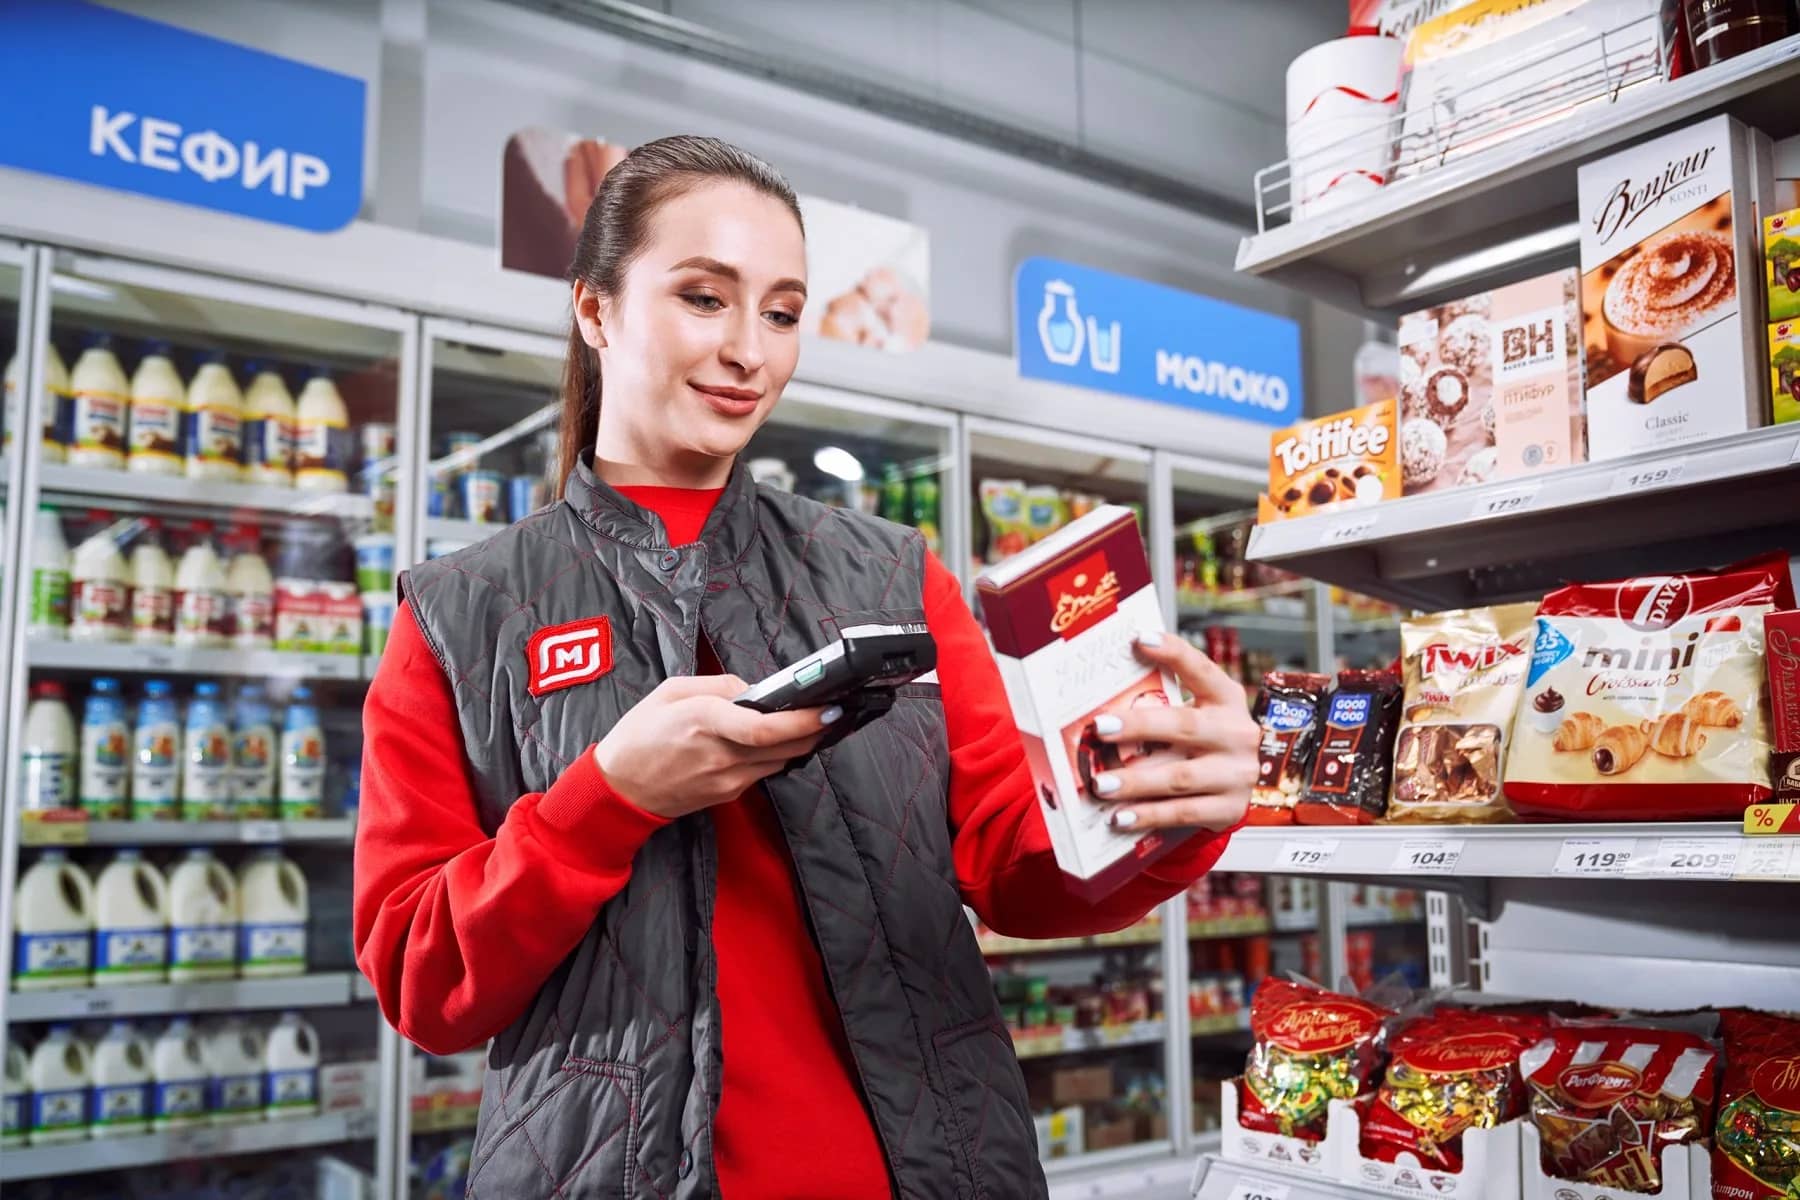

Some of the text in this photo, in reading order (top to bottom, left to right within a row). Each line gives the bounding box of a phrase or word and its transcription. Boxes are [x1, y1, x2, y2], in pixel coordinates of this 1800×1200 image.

[89, 104, 331, 200] КЕФИР
[1593, 146, 1715, 245] Bonjour
[1669, 184, 1709, 205] KONTI
[1503, 319, 1554, 363] BH
[1156, 350, 1289, 412] МОЛОКО
[1503, 384, 1555, 406] ПТИФУР
[1645, 410, 1690, 430] Classic
[1275, 416, 1389, 477] Toffifee
[1628, 470, 1668, 485] 159
[1488, 497, 1521, 511] 179
[1628, 576, 1686, 626] 7 DAYS
[1582, 632, 1700, 670] mini
[1585, 671, 1680, 697] Croissants
[1273, 705, 1308, 718] GOOD
[1336, 699, 1366, 710] GOOD
[1333, 711, 1364, 722] FOOD
[1290, 851, 1320, 863] 179
[1411, 852, 1446, 865] 104
[1574, 853, 1616, 867] 119
[1670, 854, 1720, 868] 209
